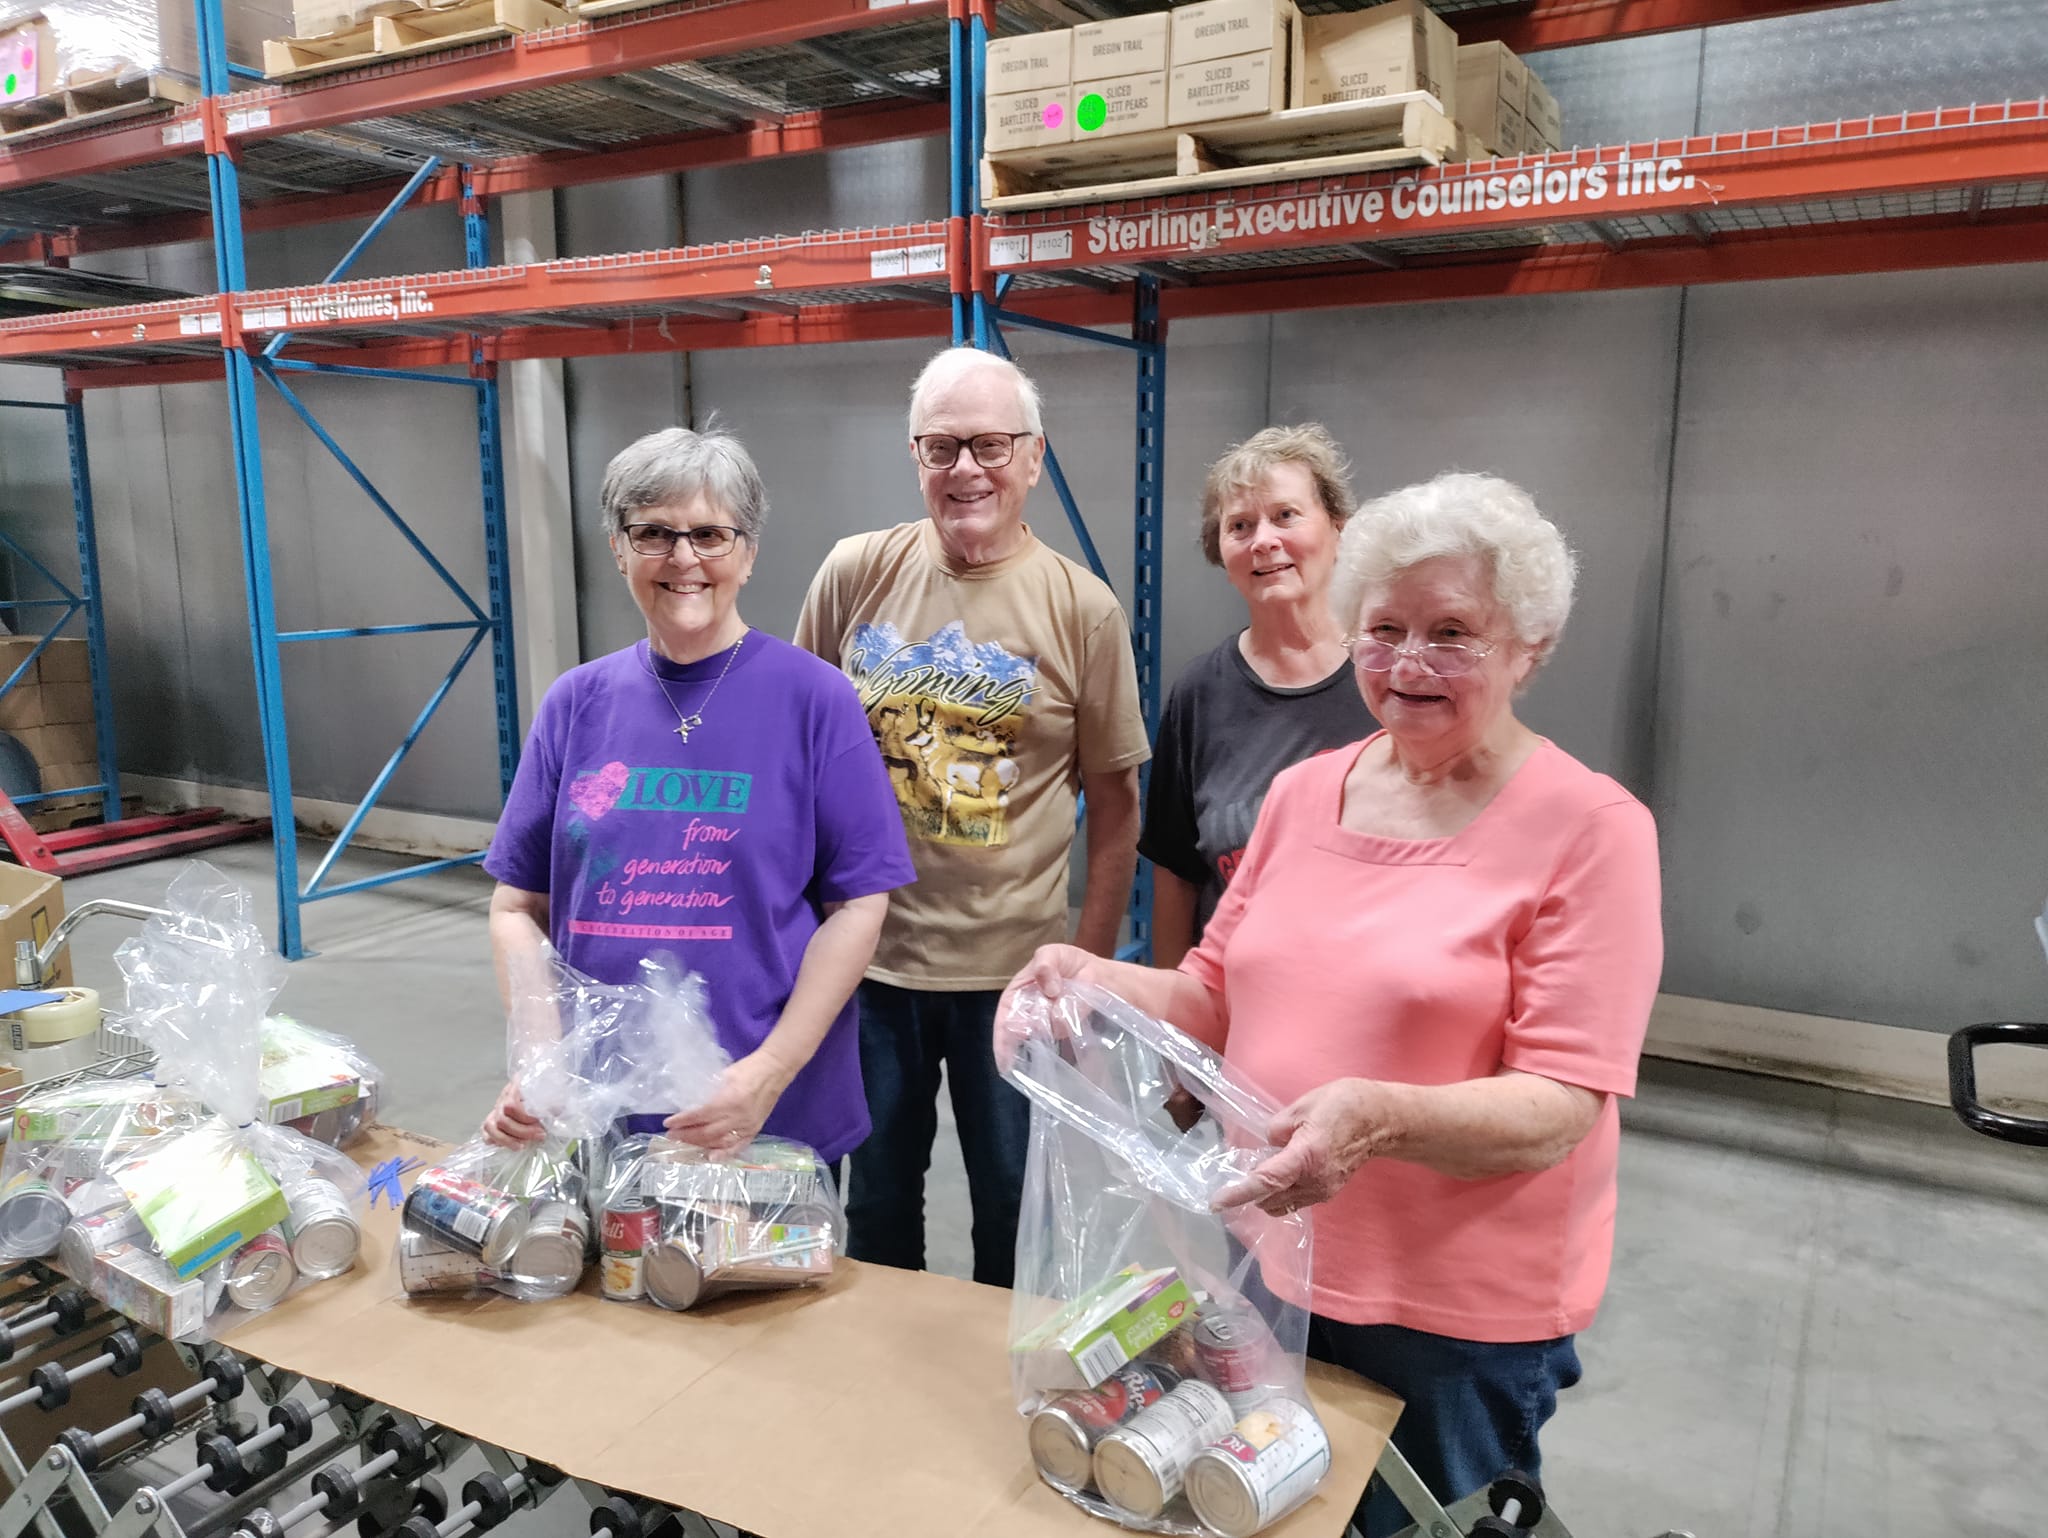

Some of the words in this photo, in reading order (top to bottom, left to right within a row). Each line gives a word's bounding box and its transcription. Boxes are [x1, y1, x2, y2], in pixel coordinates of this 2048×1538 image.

[1194, 22, 1226, 39] OREGON
[1227, 17, 1250, 32] TRAIL
[1092, 42, 1122, 57] OREGON
[1123, 40, 1144, 51] TRAIL
[1001, 59, 1028, 73] OREGON
[1030, 57, 1049, 69] TRAIL
[1205, 67, 1233, 82] SLICED
[1187, 82, 1224, 100] BARTLETT
[1225, 79, 1251, 94] PEARS
[1340, 72, 1369, 88] SLICED
[1106, 84, 1132, 99] SLICED
[1322, 88, 1360, 104] BARTLETT
[1361, 84, 1387, 100] PEARS
[1015, 97, 1039, 111] SLICED
[1125, 97, 1149, 112] PEARS
[1000, 112, 1031, 128] BARTLETT
[1088, 208, 1209, 254] Sterling
[1215, 186, 1385, 240] Executive
[1391, 161, 1608, 220] Counselors
[1617, 151, 1695, 197] Inc.
[336, 291, 399, 320] Homes,
[400, 286, 433, 314] Inc.
[849, 641, 1042, 727] Wyoming
[632, 771, 747, 809] LOVE
[682, 817, 741, 851] from
[621, 853, 732, 886] generation
[596, 881, 616, 905] to
[618, 885, 735, 916] generation
[701, 928, 728, 938] AGE
